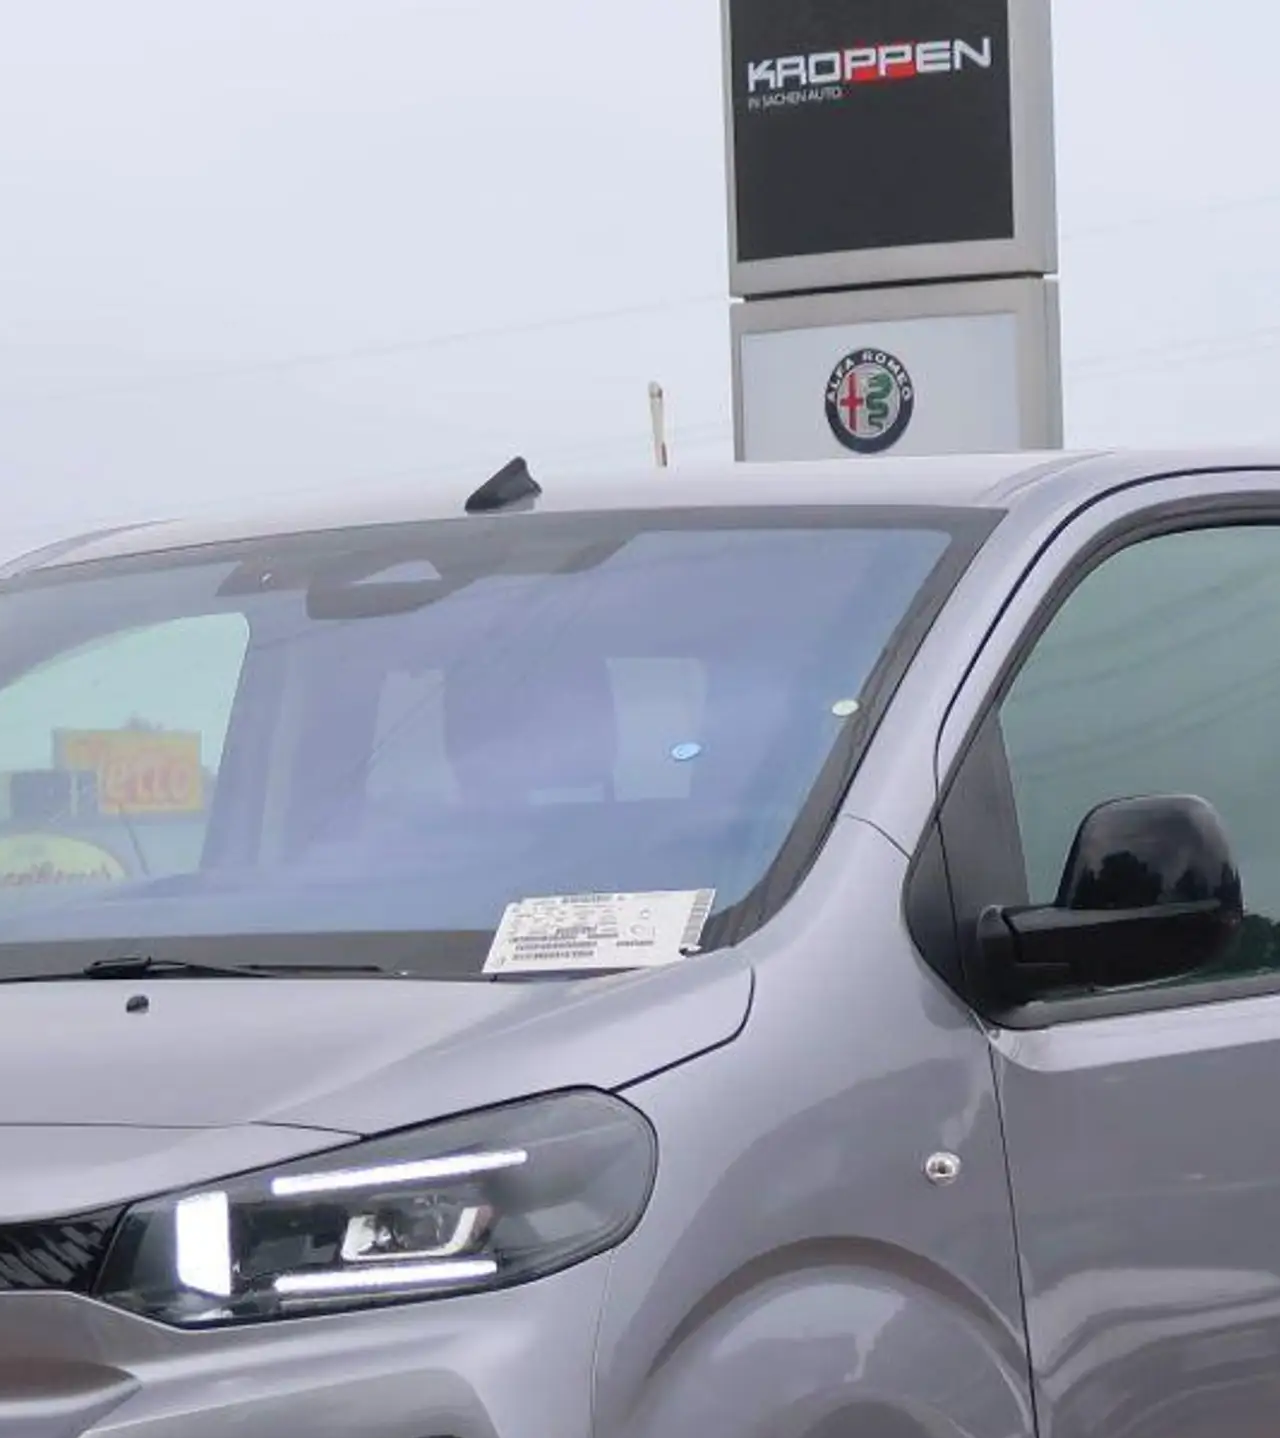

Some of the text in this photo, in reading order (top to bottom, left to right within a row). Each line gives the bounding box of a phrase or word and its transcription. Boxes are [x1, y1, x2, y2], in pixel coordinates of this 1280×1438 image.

[747, 37, 992, 93] KROPPEN
[827, 350, 911, 402] ALFA ROMEO
